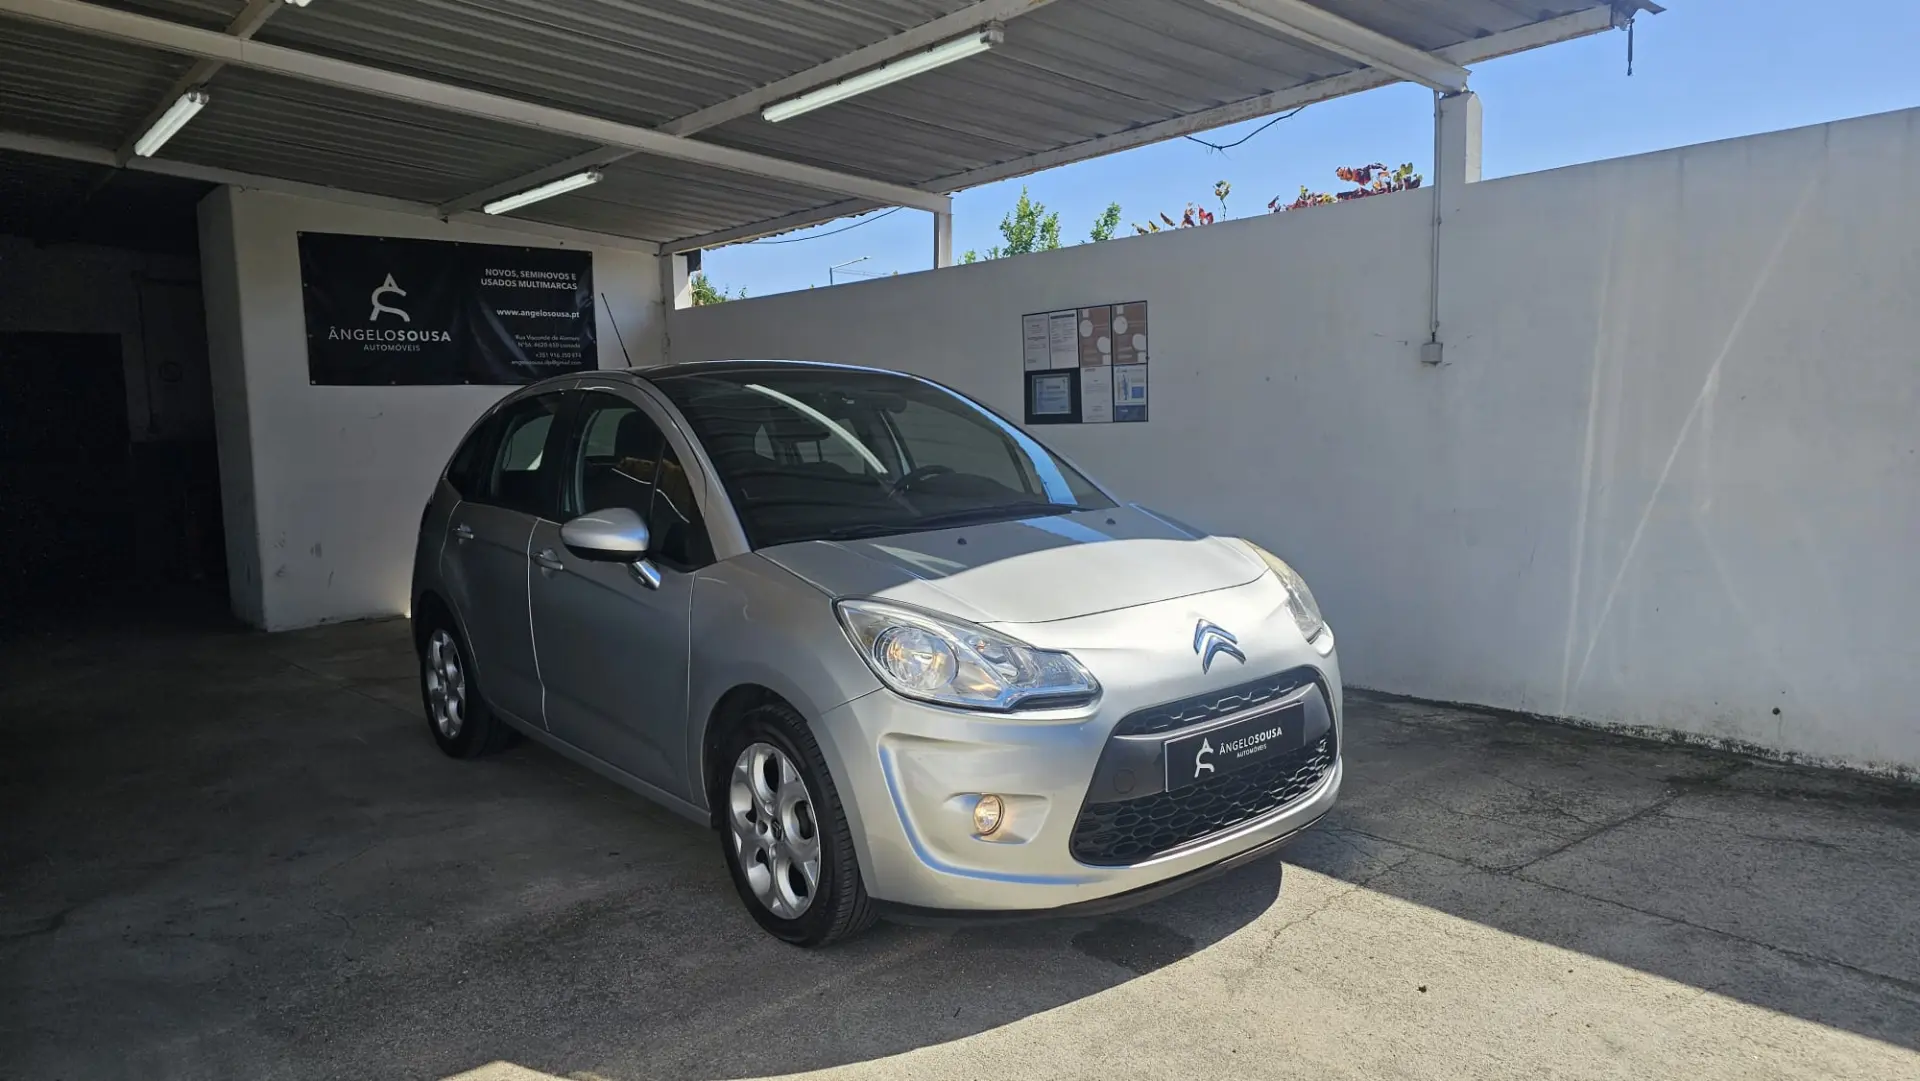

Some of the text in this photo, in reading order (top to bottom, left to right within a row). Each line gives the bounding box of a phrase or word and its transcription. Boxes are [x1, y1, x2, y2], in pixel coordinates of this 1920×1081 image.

[485, 268, 577, 281] NOVOS, SEMINOVOS E
[481, 278, 578, 290] USADOS MULTIMARCAS
[496, 309, 580, 319] www.angelosousa.pt
